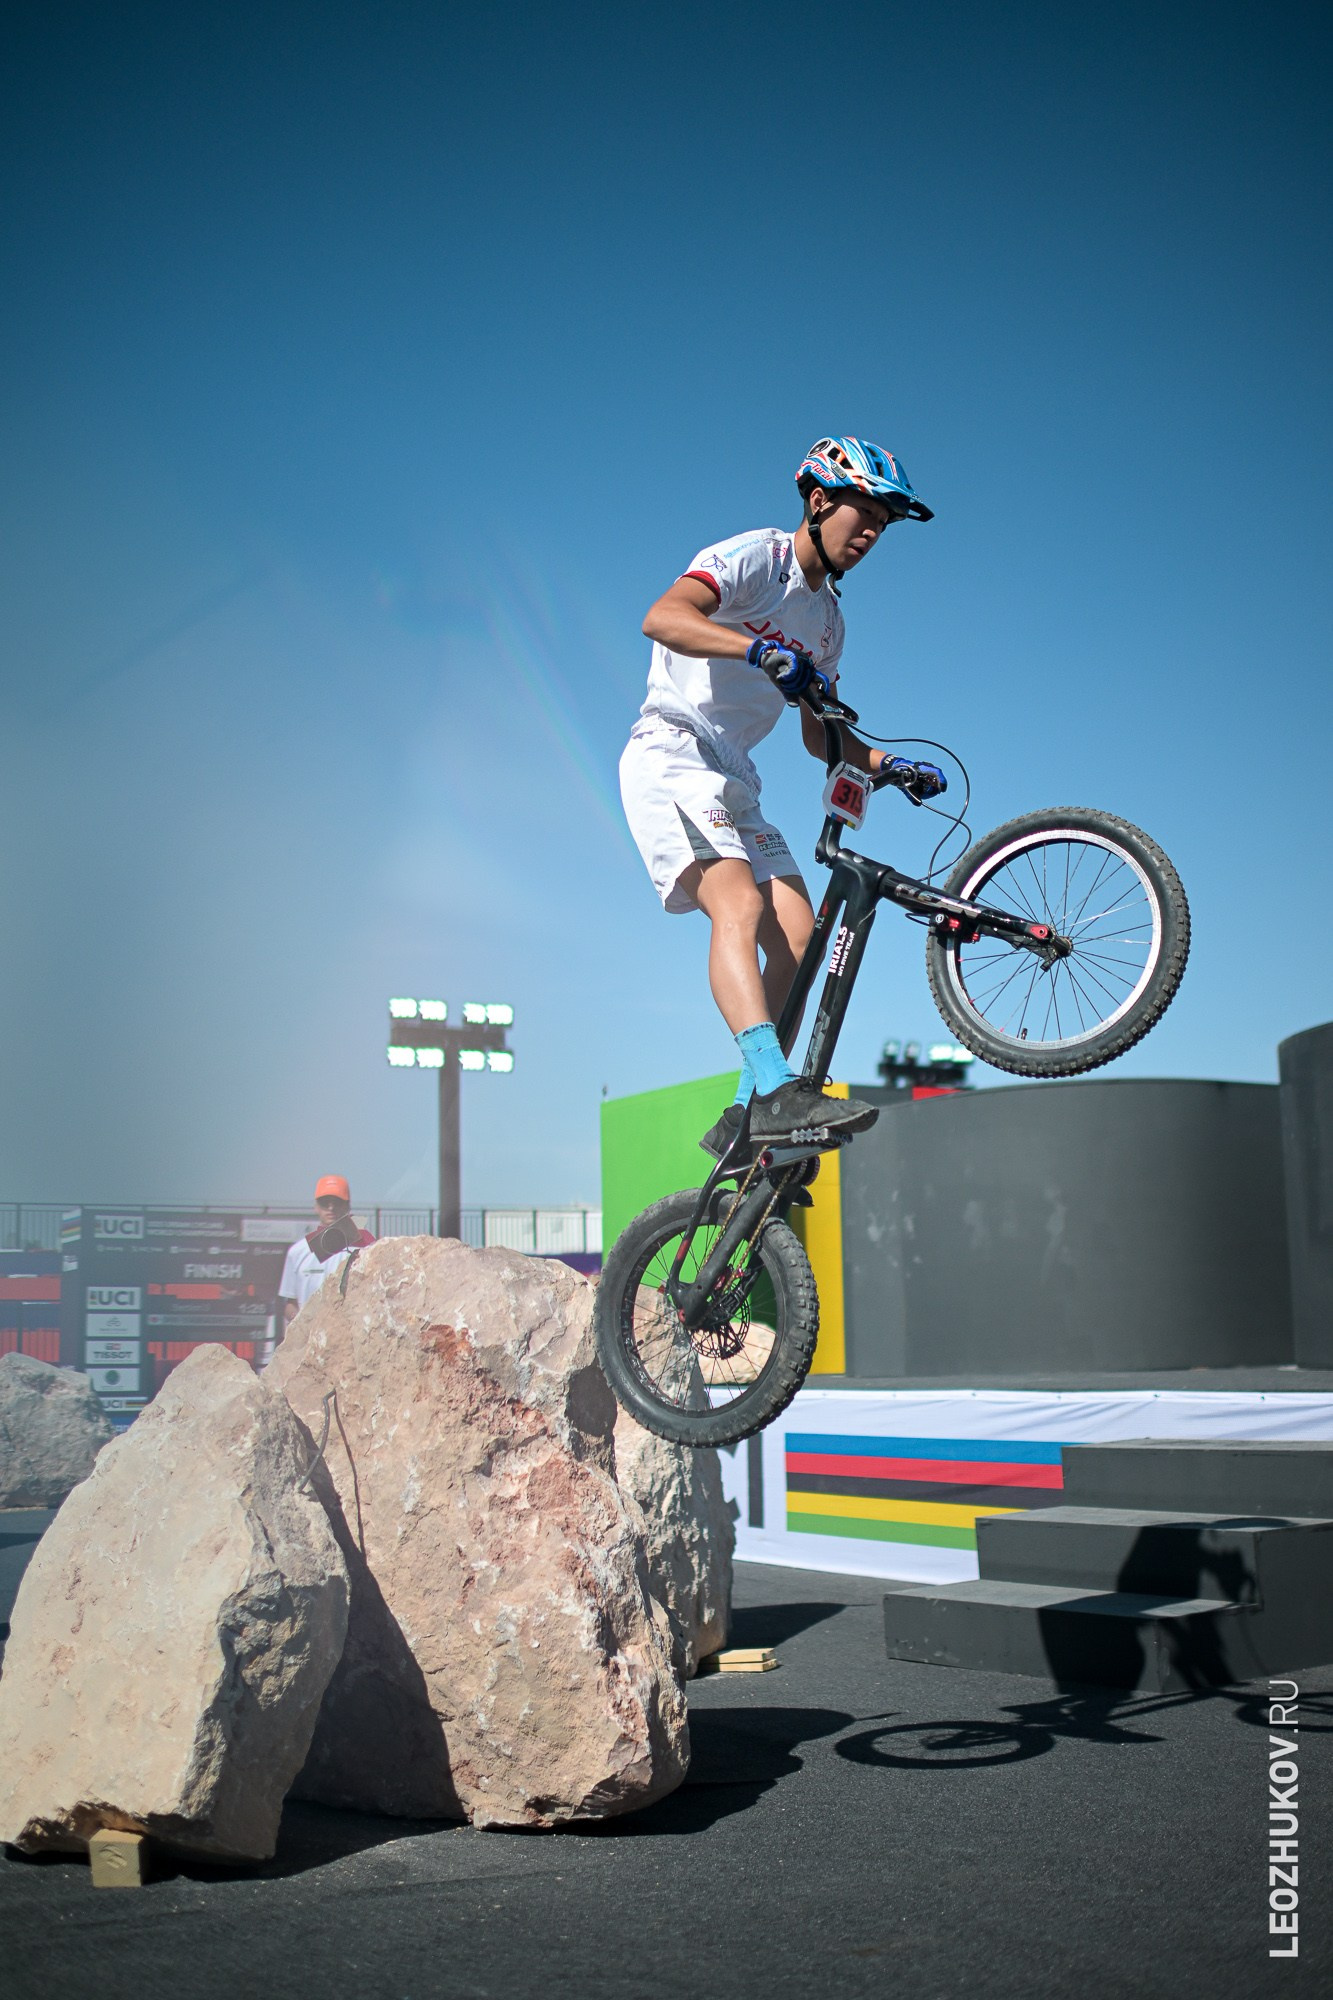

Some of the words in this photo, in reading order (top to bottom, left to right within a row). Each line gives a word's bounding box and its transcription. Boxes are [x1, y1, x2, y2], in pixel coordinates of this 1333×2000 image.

[103, 1219, 139, 1235] UCI
[184, 1263, 242, 1279] FINISH
[98, 1291, 135, 1306] UCI
[93, 1351, 133, 1360] TISSOT
